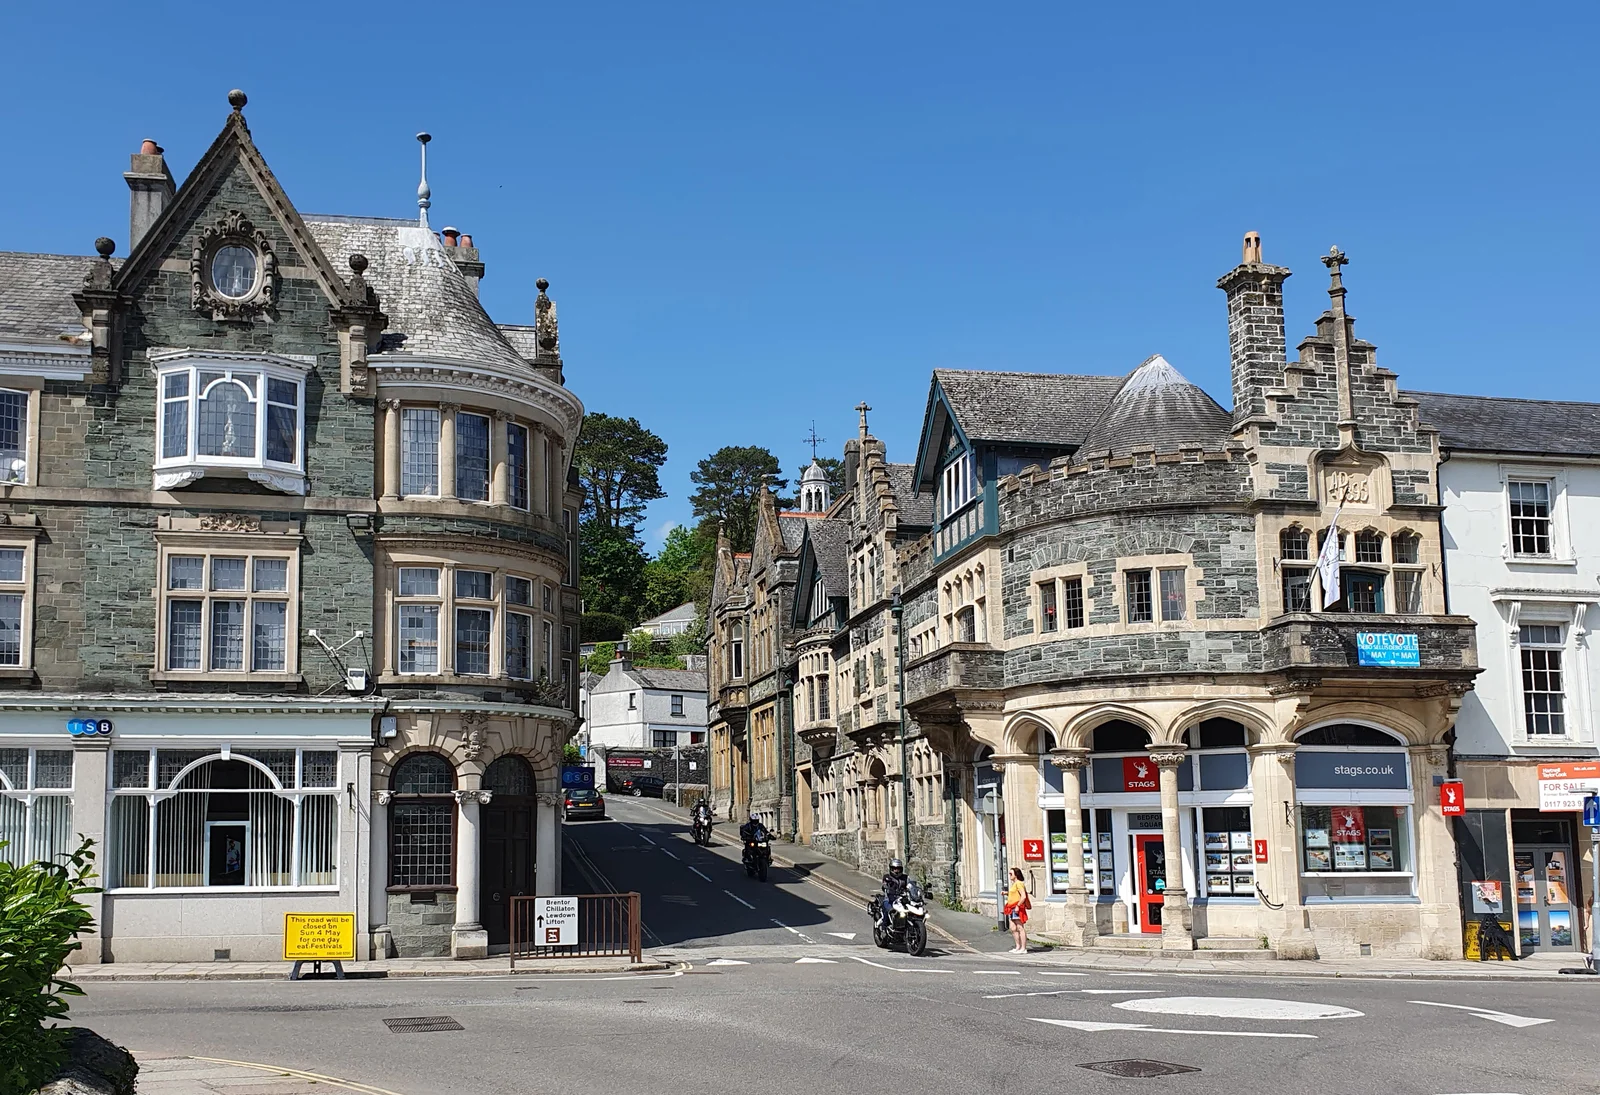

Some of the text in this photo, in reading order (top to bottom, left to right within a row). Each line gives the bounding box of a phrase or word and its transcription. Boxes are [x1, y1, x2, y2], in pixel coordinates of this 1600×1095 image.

[1339, 479, 1369, 502] 1895
[1358, 634, 1418, 646] VOTE VOTE
[71, 721, 110, 732] TSB
[1334, 765, 1394, 776] stags.co.uk
[1544, 783, 1561, 791] FOR
